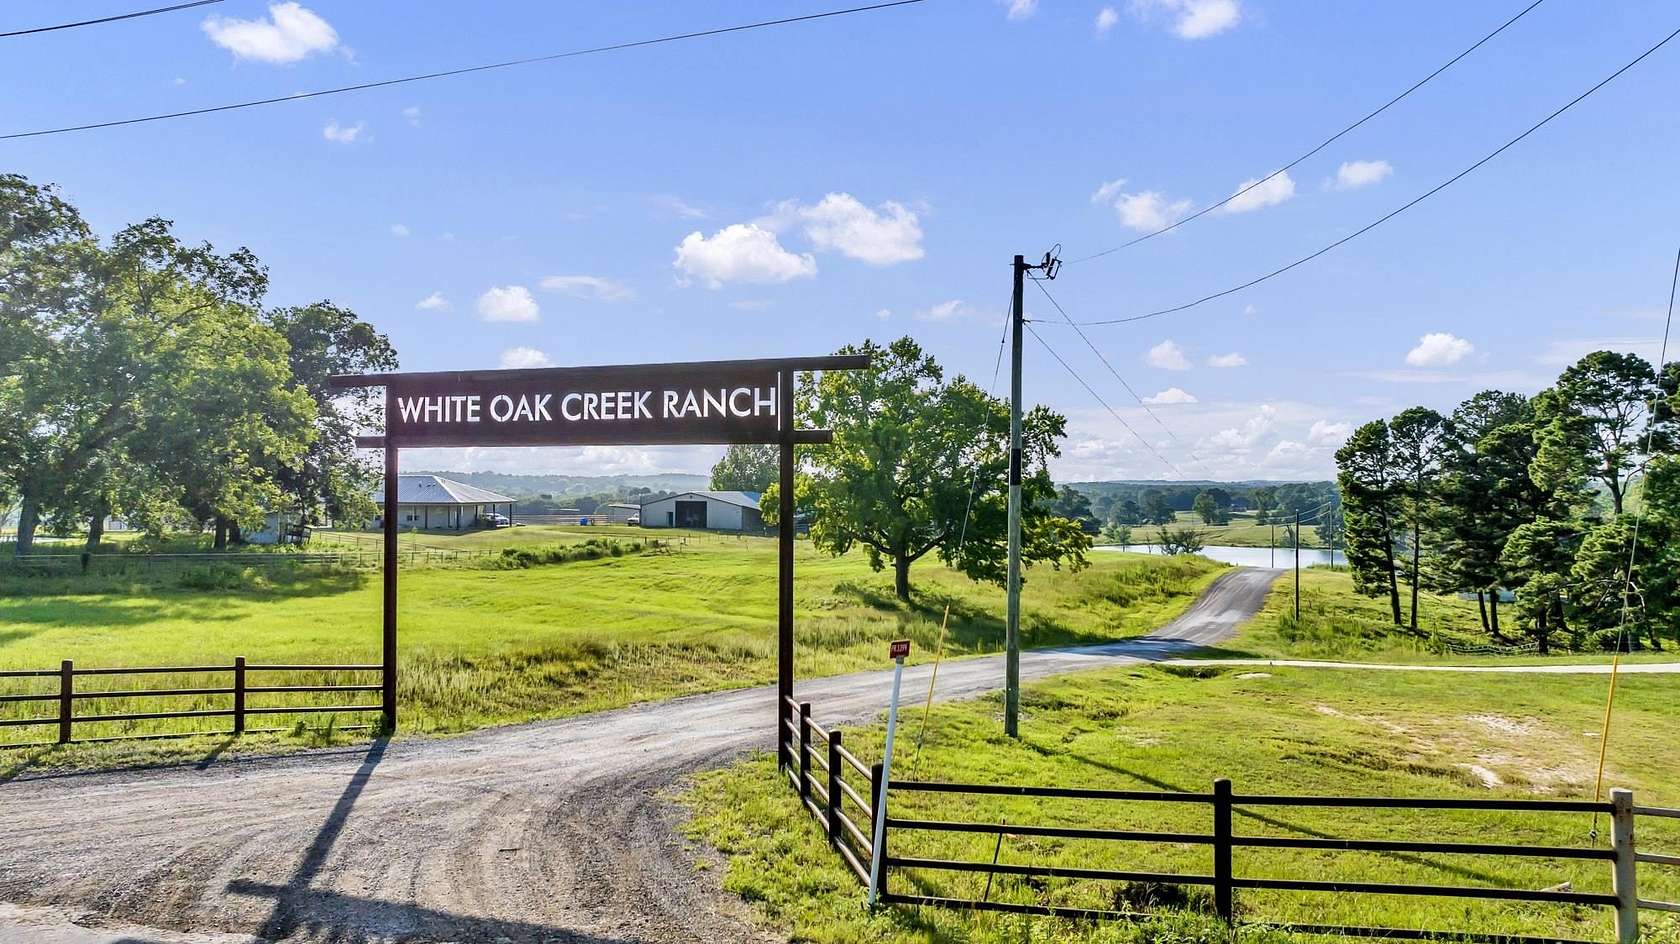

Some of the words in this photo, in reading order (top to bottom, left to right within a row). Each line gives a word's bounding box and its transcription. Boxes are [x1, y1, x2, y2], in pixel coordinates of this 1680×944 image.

[398, 395, 480, 423] WHITE
[490, 394, 552, 422] OAK
[561, 391, 653, 421] CREEK
[663, 387, 776, 418] RANCH
